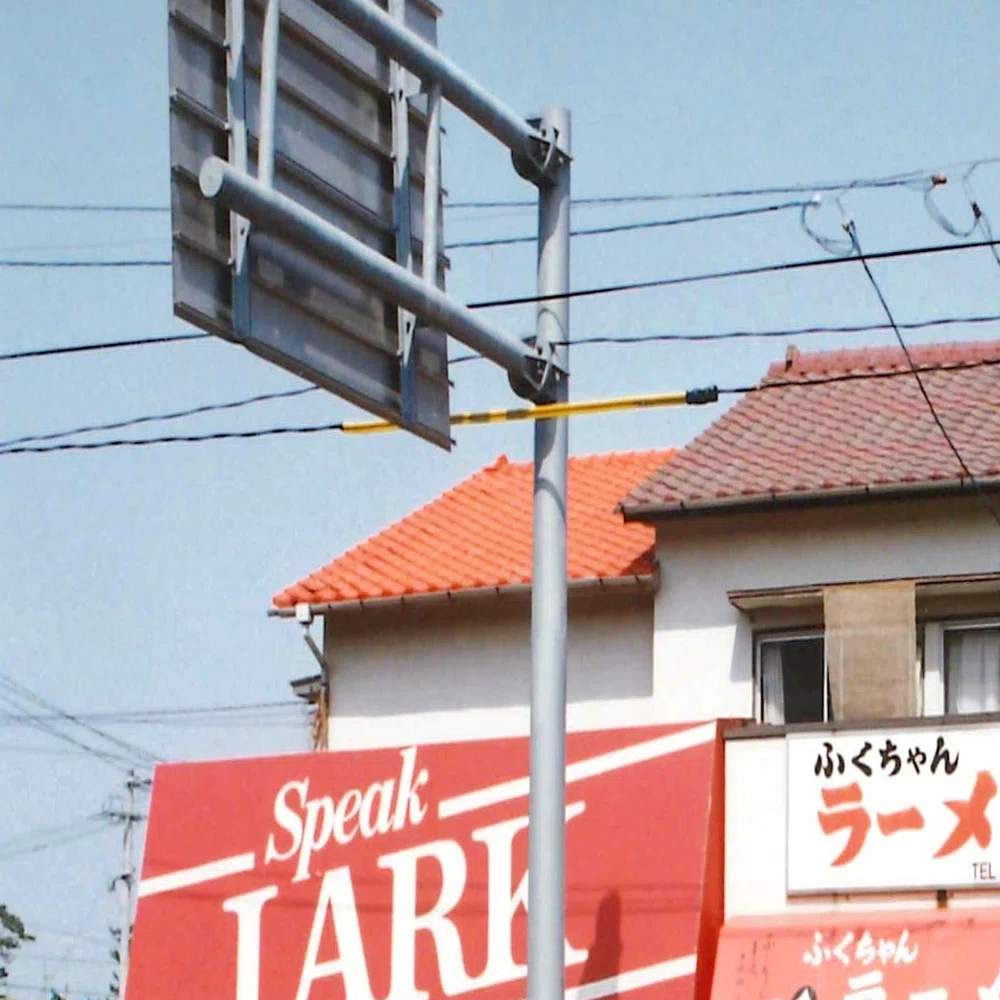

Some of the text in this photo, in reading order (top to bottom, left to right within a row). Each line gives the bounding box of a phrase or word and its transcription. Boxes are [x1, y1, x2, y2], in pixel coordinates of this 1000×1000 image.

[814, 736, 960, 779] ふくちゃん
[264, 745, 430, 883] Speak
[971, 861, 997, 880] TEL
[803, 928, 918, 966] ふくちゃん
